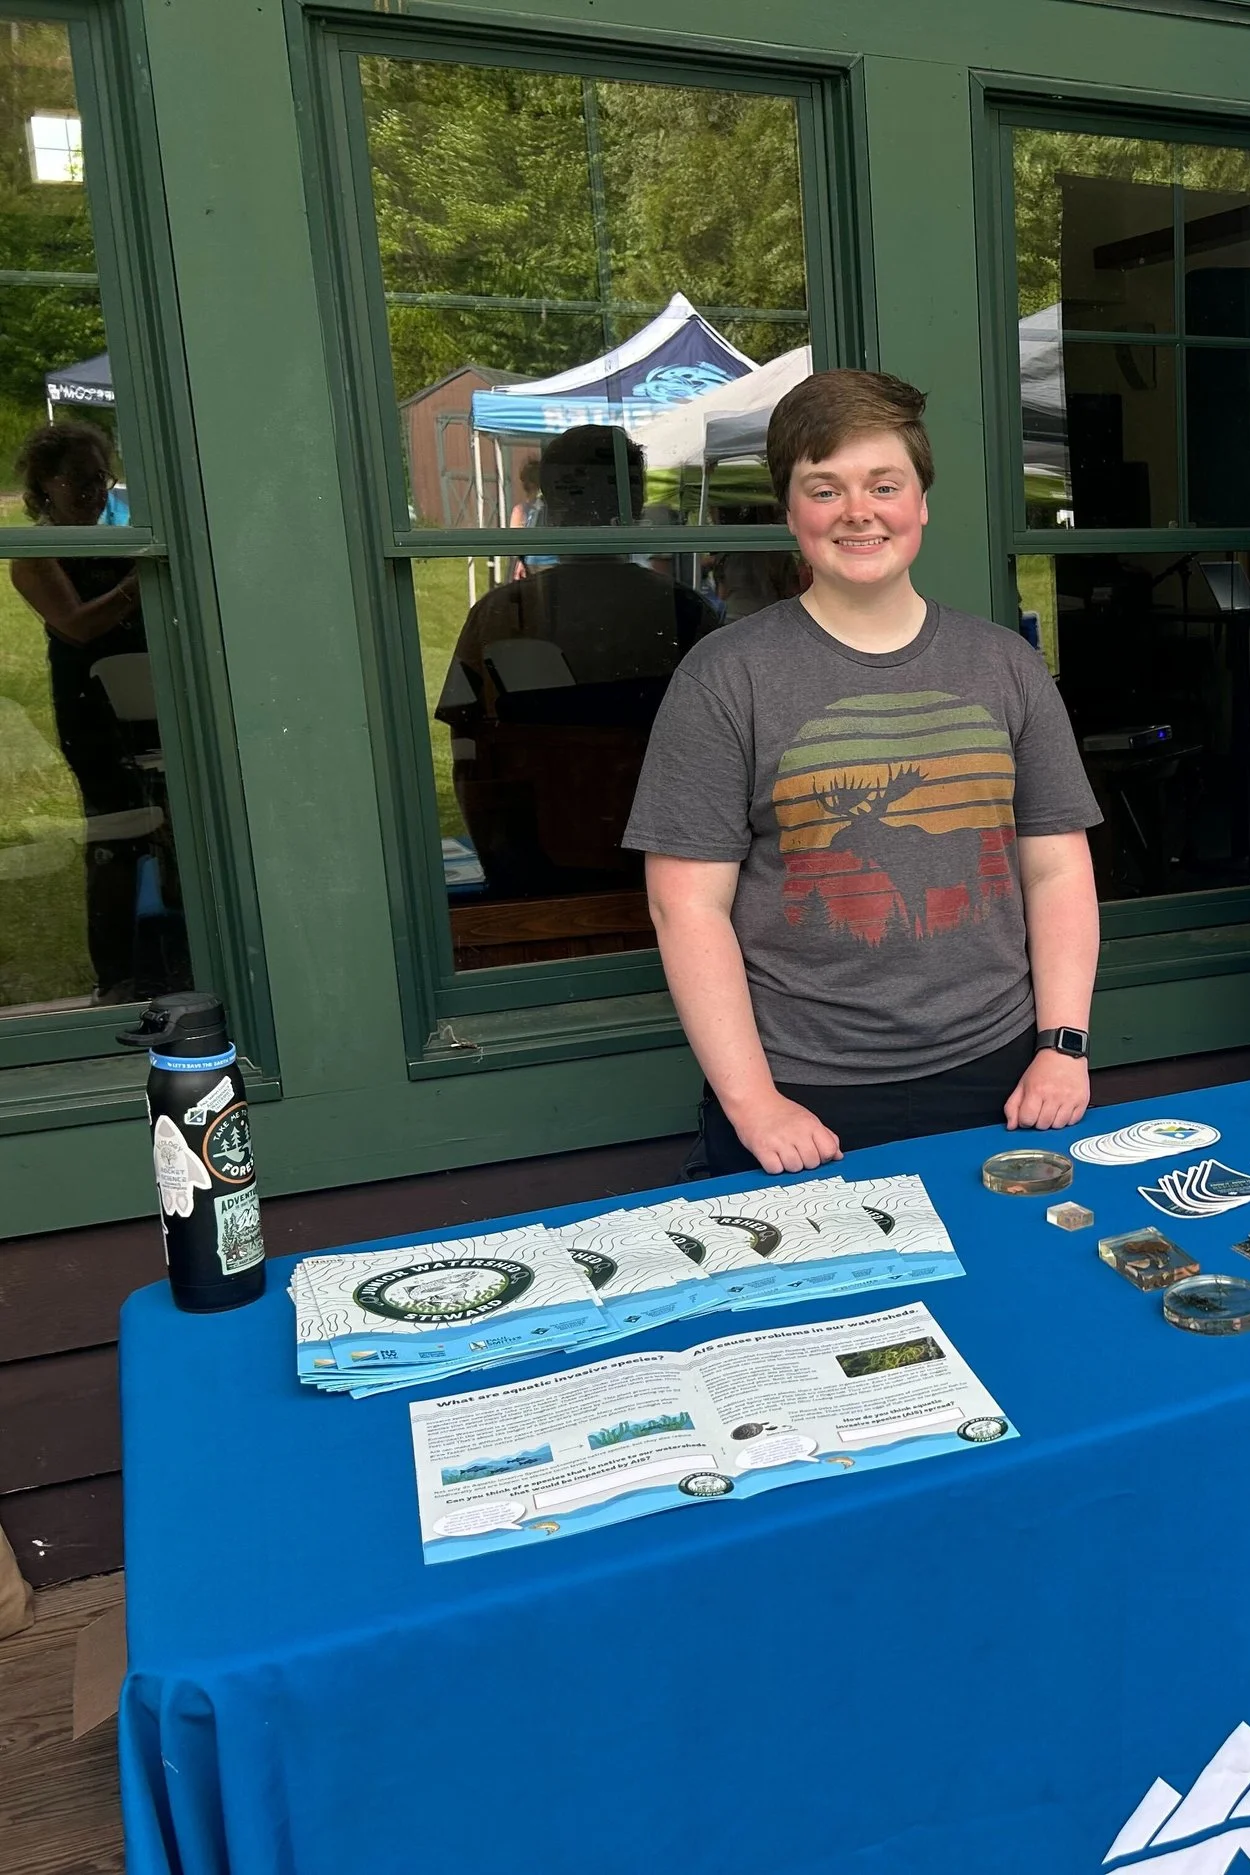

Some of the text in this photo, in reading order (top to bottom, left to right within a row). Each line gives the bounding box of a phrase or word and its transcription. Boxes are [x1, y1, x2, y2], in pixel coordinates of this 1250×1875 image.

[213, 1120, 230, 1141] TAKE
[230, 1111, 240, 1121] ME
[712, 1216, 768, 1232] RSHED
[361, 1258, 523, 1296] JUNIOR WATERSHED
[403, 1299, 503, 1321] STEWARD
[693, 1345, 714, 1356] AIS
[717, 1338, 752, 1347] cause
[754, 1330, 810, 1342] problems
[847, 1308, 919, 1328] watersheds.
[436, 1355, 665, 1408] What are aquatic invasive species?
[836, 1421, 870, 1429] invasive
[871, 1414, 901, 1424] species
[924, 1401, 955, 1412] spread?
[890, 1406, 911, 1414] think
[913, 1399, 943, 1409] aquatic
[446, 1497, 465, 1505] Can
[466, 1493, 484, 1502] you
[485, 1488, 511, 1497] think
[531, 1475, 565, 1487] species
[567, 1467, 586, 1477] that
[588, 1463, 596, 1471] is
[598, 1456, 626, 1467] native
[655, 1442, 707, 1453] watersheds
[510, 1455, 652, 1497] that would be impacted by AIS?
